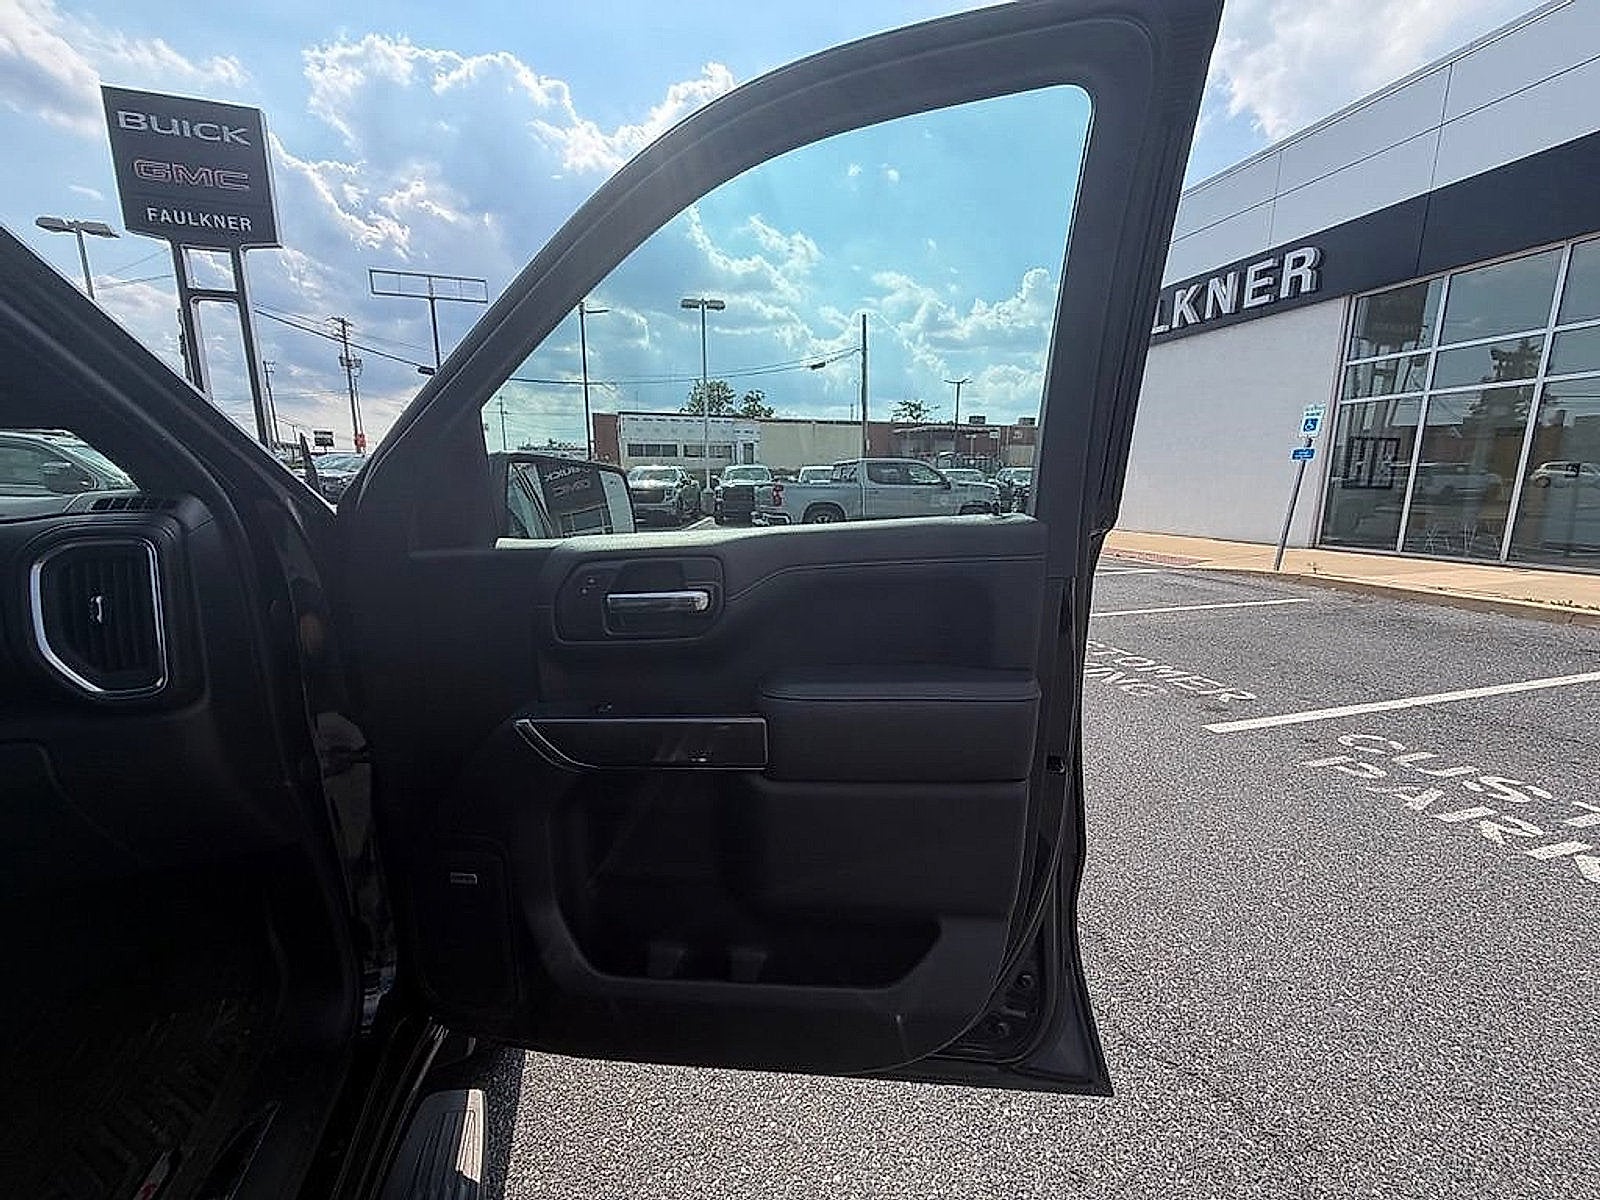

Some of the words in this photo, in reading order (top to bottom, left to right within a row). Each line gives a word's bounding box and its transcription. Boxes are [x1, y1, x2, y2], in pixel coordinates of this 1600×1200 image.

[116, 110, 251, 146] BUICK
[134, 158, 250, 191] GMC
[146, 207, 252, 232] FAULKNER
[1088, 640, 1257, 702] TOMER
